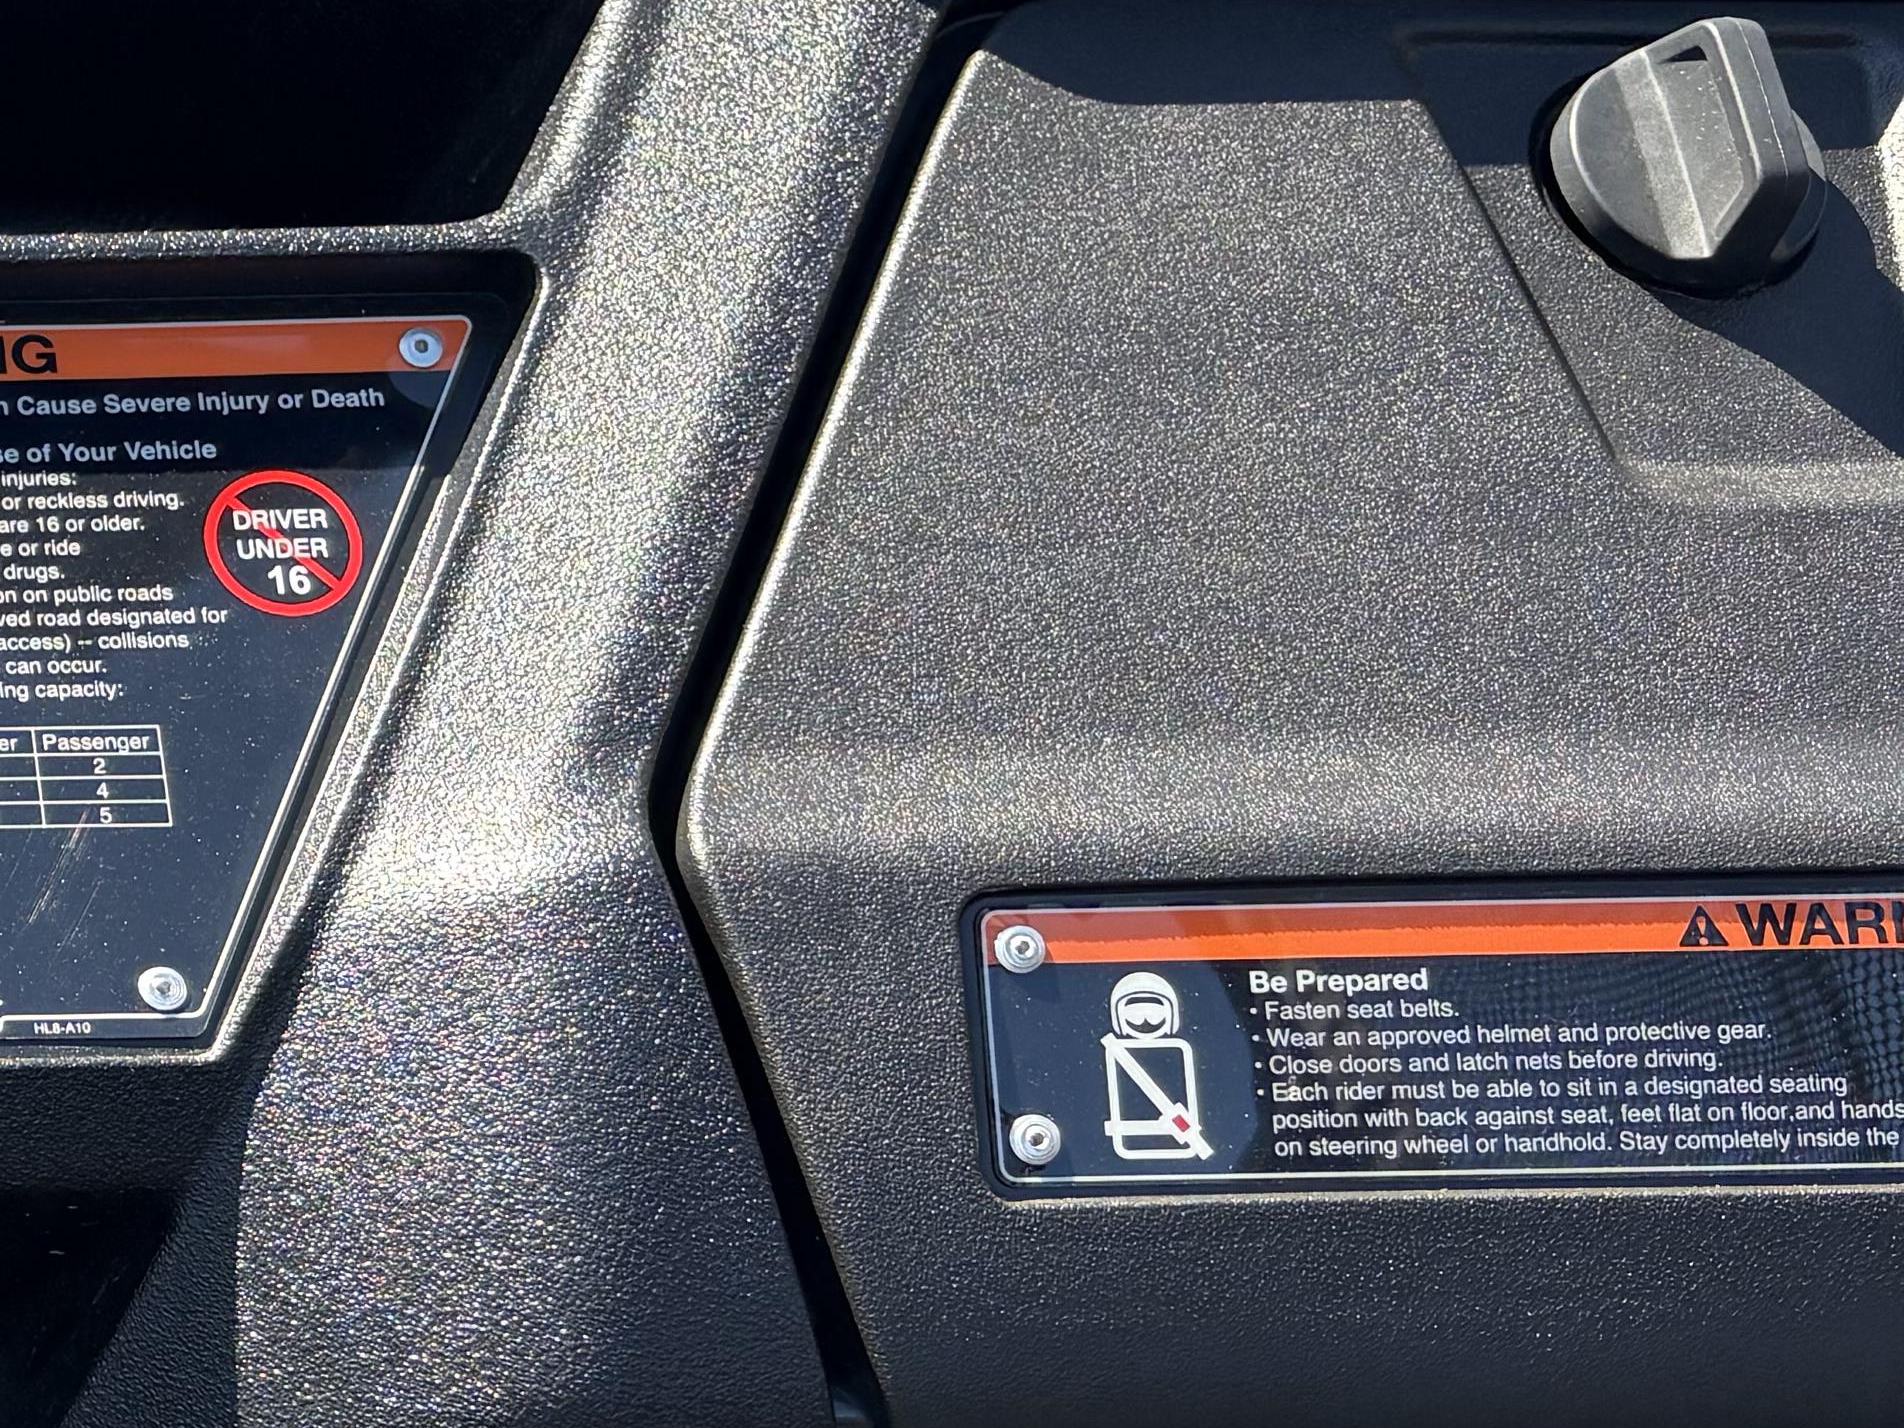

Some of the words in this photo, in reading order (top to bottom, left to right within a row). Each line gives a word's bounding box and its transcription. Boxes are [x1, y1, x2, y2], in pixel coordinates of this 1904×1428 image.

[17, 396, 96, 415] Cause
[104, 394, 190, 413] Severe
[198, 392, 269, 415] Injury
[278, 394, 303, 409] or
[312, 388, 384, 407] Death
[27, 444, 50, 462] of
[58, 443, 116, 461] Your
[124, 440, 216, 460] Vehicle
[232, 508, 328, 531] DRIVER
[236, 537, 329, 559] UNDER
[3, 563, 65, 583] drugs.
[267, 565, 312, 595] 16
[42, 734, 150, 754] Passenger
[93, 758, 107, 775] 2
[96, 782, 109, 799] 4
[99, 807, 113, 824] 5
[1249, 971, 1288, 993] Be
[1296, 968, 1428, 997] Prepared
[1265, 1001, 1340, 1020] Fasten
[1347, 1000, 1393, 1019] seat
[1400, 999, 1459, 1017] belts.
[1266, 1028, 1326, 1049] Wear
[1334, 1031, 1360, 1046] an
[1368, 1025, 1471, 1049] approved
[1477, 1024, 1551, 1043] helmet
[1558, 1022, 1598, 1042] and
[1606, 1020, 1711, 1045] protective
[1718, 1024, 1771, 1044] gear.
[1269, 1055, 1333, 1074] Close
[1339, 1054, 1402, 1073] doors
[1409, 1053, 1449, 1072] and
[1457, 1052, 1508, 1071] latch
[1516, 1052, 1562, 1070] nets
[1568, 1049, 1638, 1069] before
[1645, 1048, 1722, 1072] driving.
